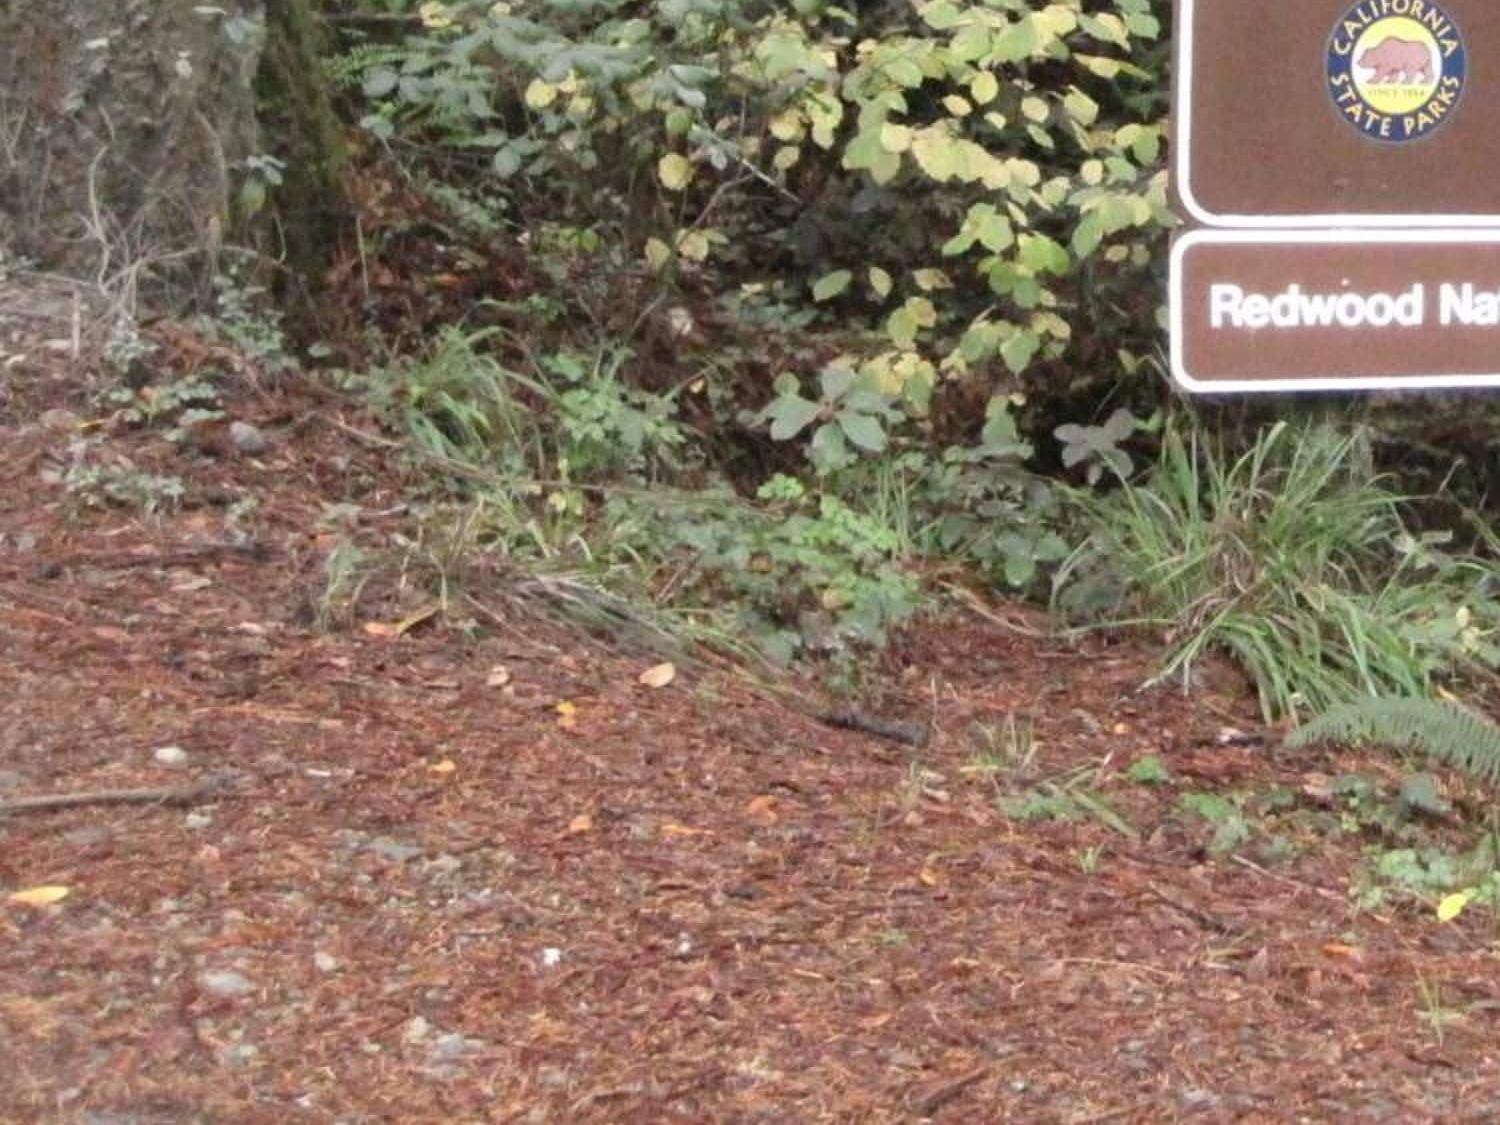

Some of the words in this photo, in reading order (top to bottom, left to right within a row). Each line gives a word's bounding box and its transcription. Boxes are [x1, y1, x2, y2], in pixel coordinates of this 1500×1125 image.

[1331, 72, 1392, 136] STATE
[1403, 76, 1459, 135] PARKS
[1210, 283, 1424, 329] Redwood
